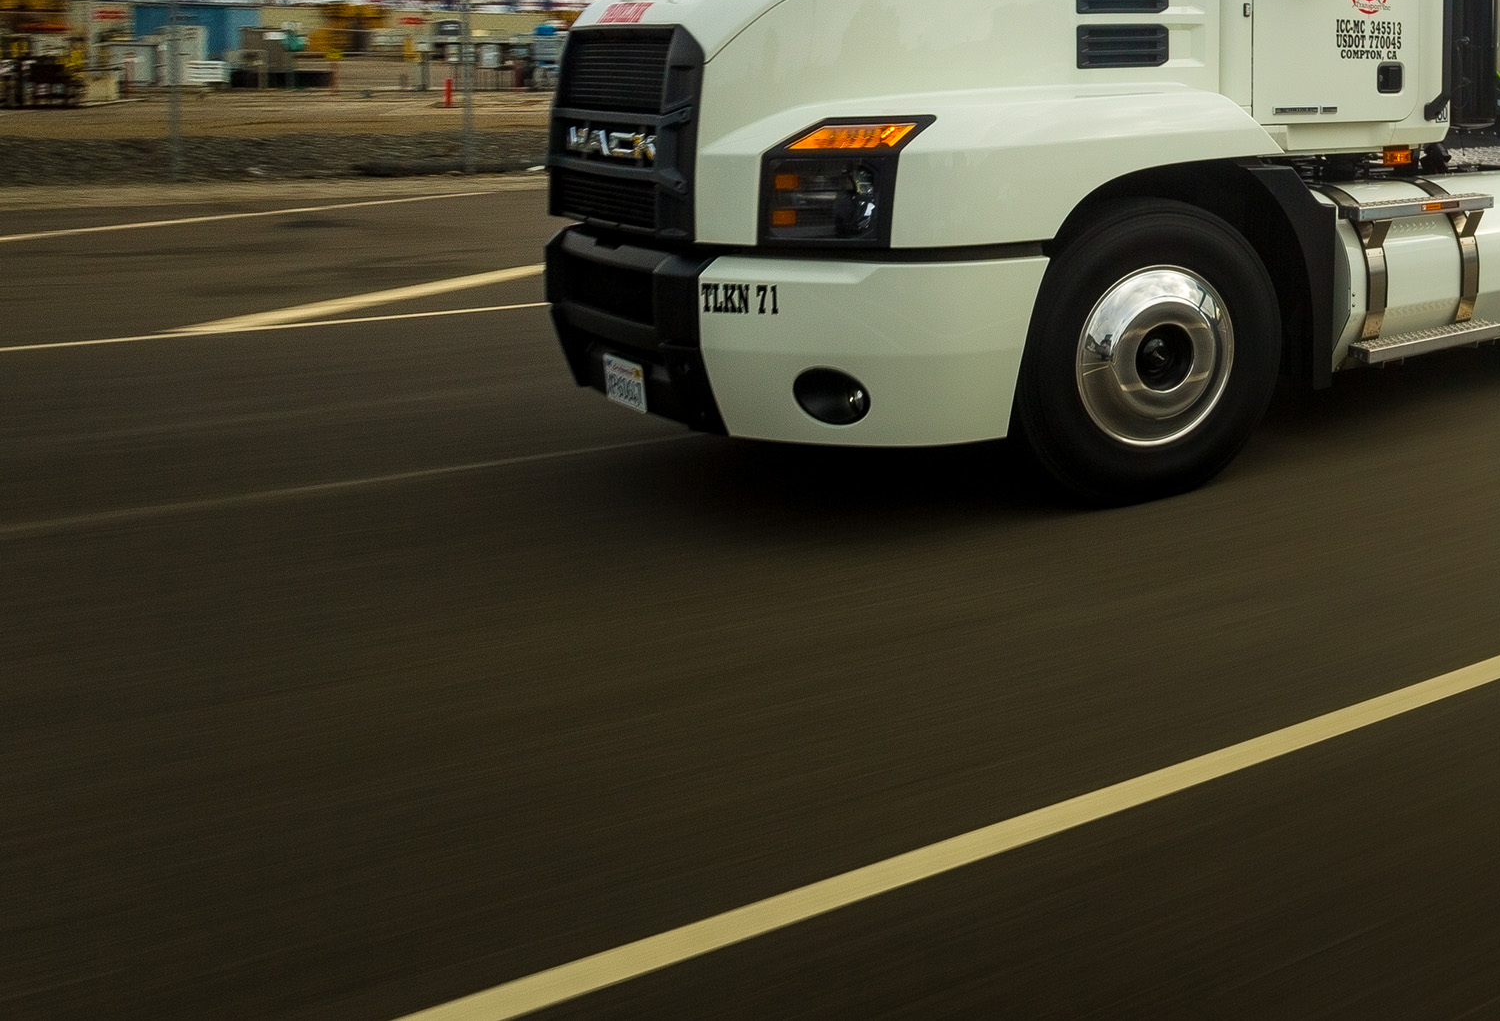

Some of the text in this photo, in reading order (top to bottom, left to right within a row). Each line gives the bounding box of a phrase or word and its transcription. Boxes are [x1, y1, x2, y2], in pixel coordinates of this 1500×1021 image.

[1336, 19, 1402, 35] ICC-MC 345513
[1336, 34, 1402, 50] USDOT 770045
[1340, 49, 1398, 61] COMPTON, CA
[701, 282, 779, 315] TLKN 71
